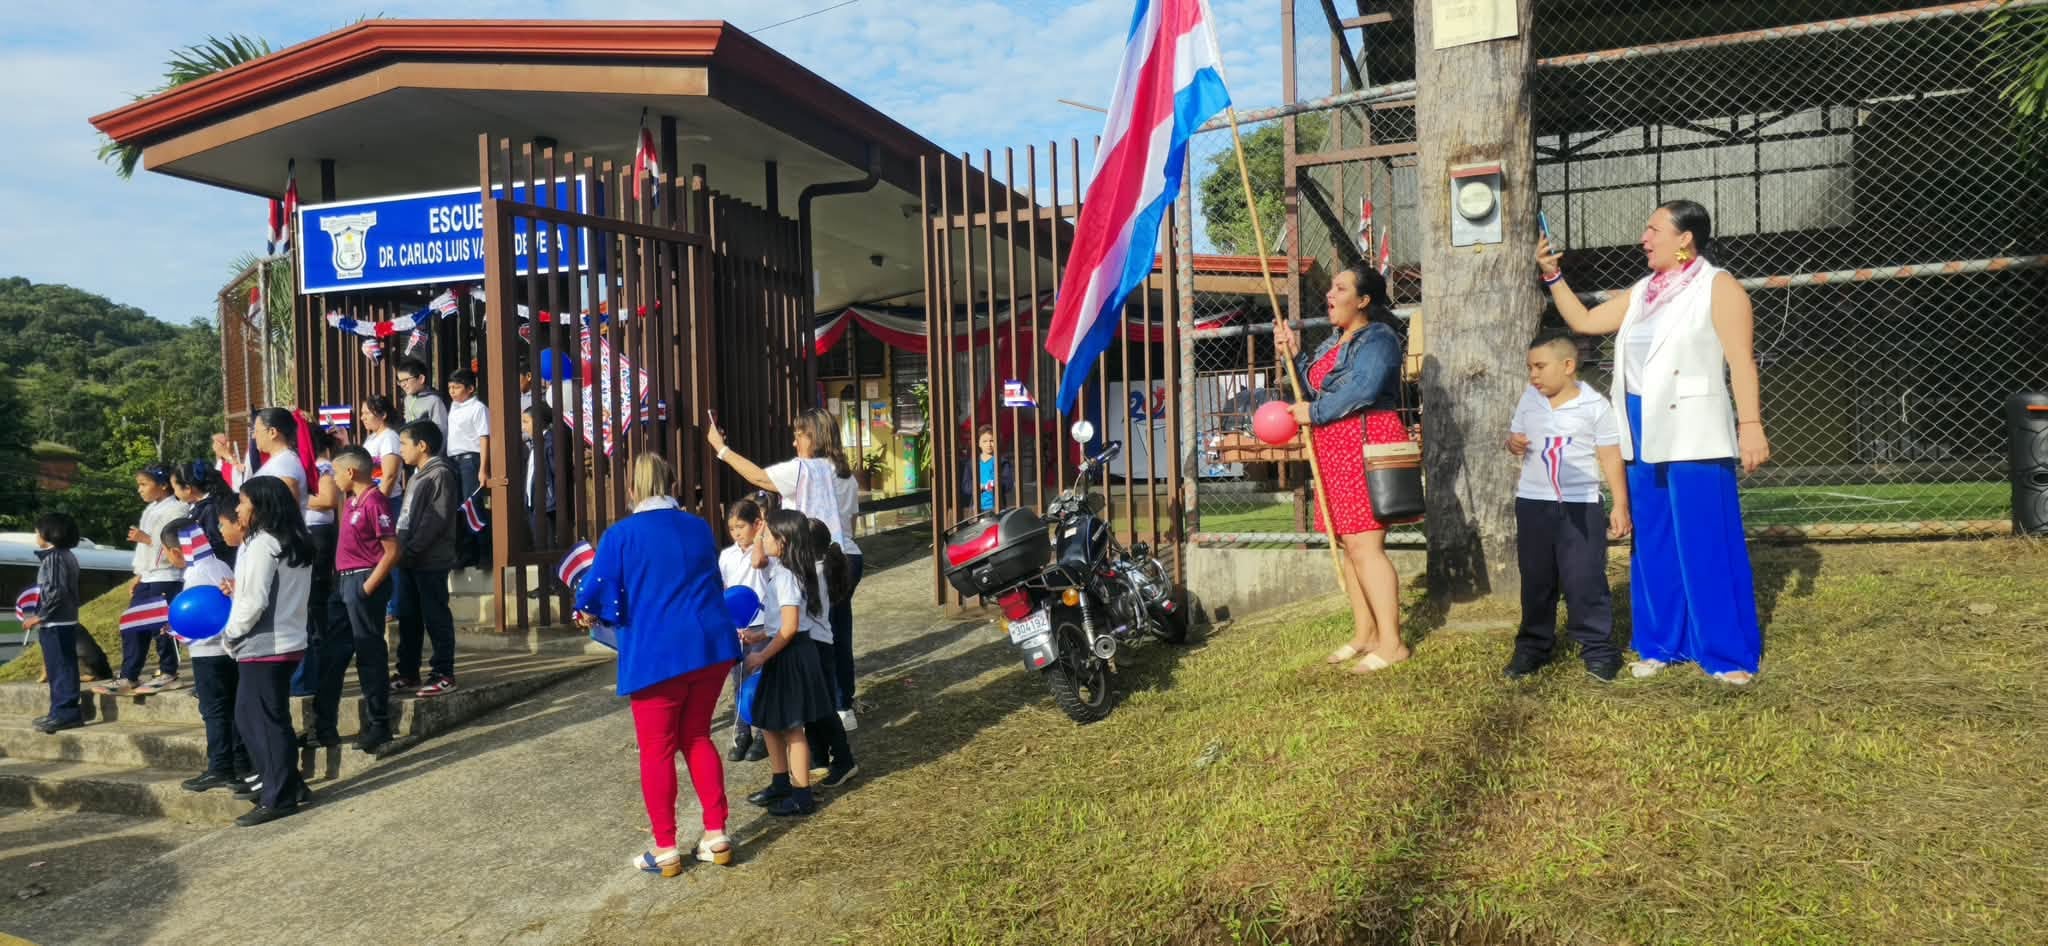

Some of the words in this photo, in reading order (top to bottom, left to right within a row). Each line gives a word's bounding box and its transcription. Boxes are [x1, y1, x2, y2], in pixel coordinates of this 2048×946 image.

[379, 245, 397, 268] DR.
[399, 240, 443, 267] CARLOS
[445, 238, 470, 263] LUIS
